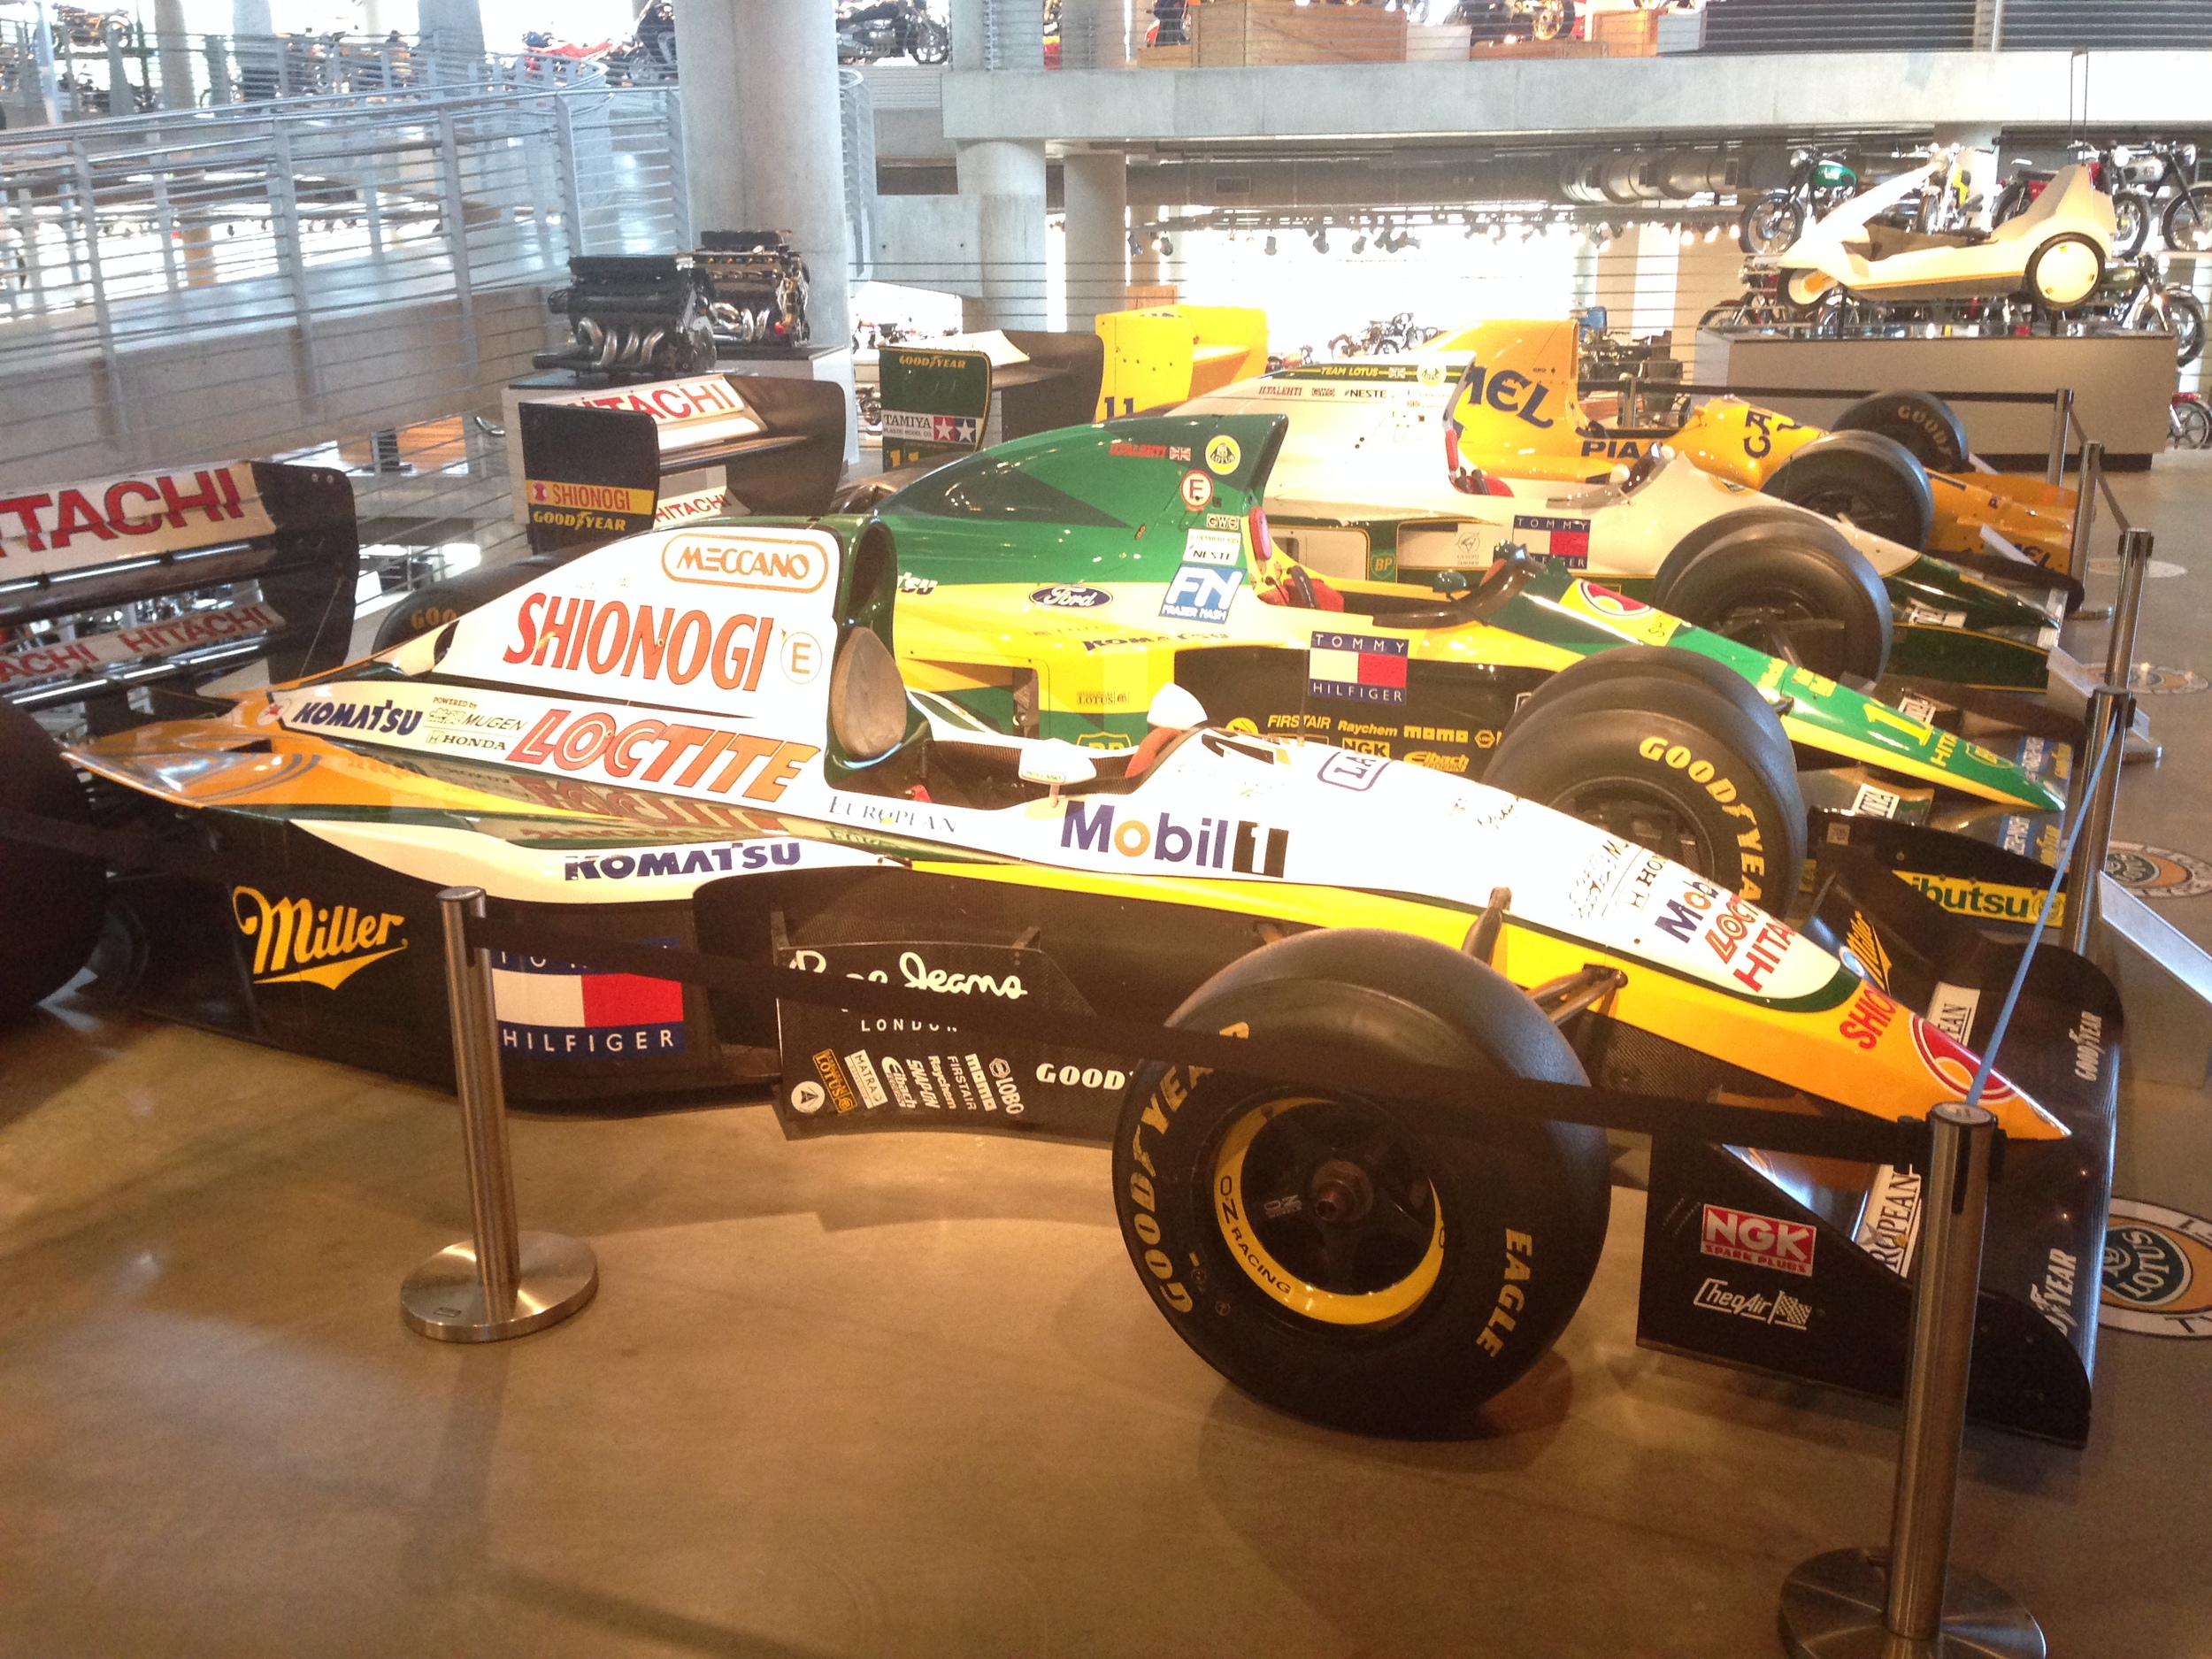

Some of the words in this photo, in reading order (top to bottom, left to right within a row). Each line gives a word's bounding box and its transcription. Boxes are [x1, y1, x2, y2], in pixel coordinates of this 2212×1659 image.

[899, 355, 966, 368] GOODYEAR
[1321, 366, 1346, 376] TEAM
[1348, 367, 1379, 377] LOTUS
[1350, 389, 1386, 398] NESTE
[884, 414, 932, 428] TAMIYA
[552, 484, 631, 511] SHIONOGI
[655, 494, 731, 522] HITACHI
[0, 467, 244, 557] TACHI
[533, 510, 626, 532] GOODYEAR
[1517, 518, 1588, 530] TOMMY
[676, 546, 810, 580] MECCANO
[1375, 557, 1392, 572] BP
[1043, 587, 1095, 607] Ford
[1199, 608, 1227, 621] NASH
[119, 606, 273, 654] HITACHI
[503, 592, 774, 692] SHIONOGI
[1315, 634, 1405, 653] TOMMY
[791, 642, 811, 674] E
[434, 696, 467, 709] POWERED
[1313, 682, 1403, 703] HILFIGER
[291, 700, 423, 736] KOMATSU
[465, 713, 528, 732] MUGEN
[1267, 714, 1331, 730] FIRSTAIR
[1338, 719, 1398, 736] Raychem
[442, 733, 506, 750] HONDA
[1403, 725, 1469, 742] momo
[505, 709, 821, 803] LOCTITE
[1343, 738, 1390, 757] NGK
[1061, 799, 1229, 869] Mobil
[565, 841, 802, 881] KOMATSU
[233, 885, 405, 974] Miller
[899, 951, 1028, 1000] Jeans
[861, 1018, 957, 1033] LOND
[503, 1028, 674, 1053] HILFIGER
[816, 1054, 841, 1102] LOTUS
[855, 1054, 878, 1094] MATRA
[928, 1055, 956, 1110] Raychem
[947, 1056, 977, 1111] FIRSTAIR
[1706, 1209, 1810, 1263] NGK
[1231, 1226, 1292, 1294] RACING
[1704, 1244, 1756, 1263] SPARK
[1757, 1254, 1808, 1274] PLUGS
[2116, 1230, 2170, 1299] LOTUS
[1475, 1226, 1532, 1358] EAGLE
